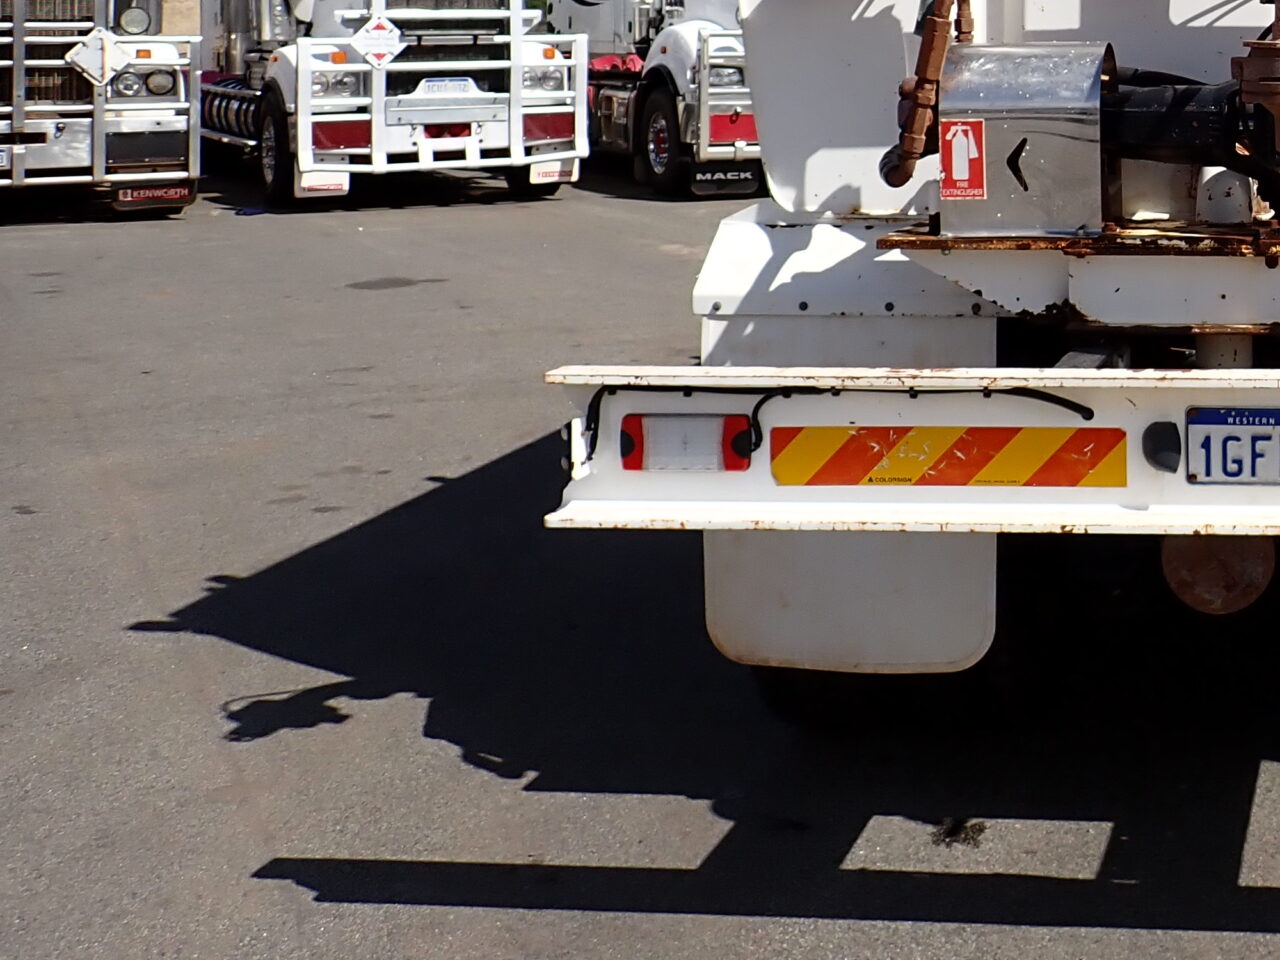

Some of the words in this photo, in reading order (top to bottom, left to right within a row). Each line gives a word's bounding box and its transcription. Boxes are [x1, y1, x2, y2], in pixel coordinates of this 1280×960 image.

[695, 171, 753, 180] MACK
[132, 188, 189, 198] KENWORTH
[942, 188, 983, 196] EXTINGUISHER
[1227, 417, 1275, 425] WESTERN
